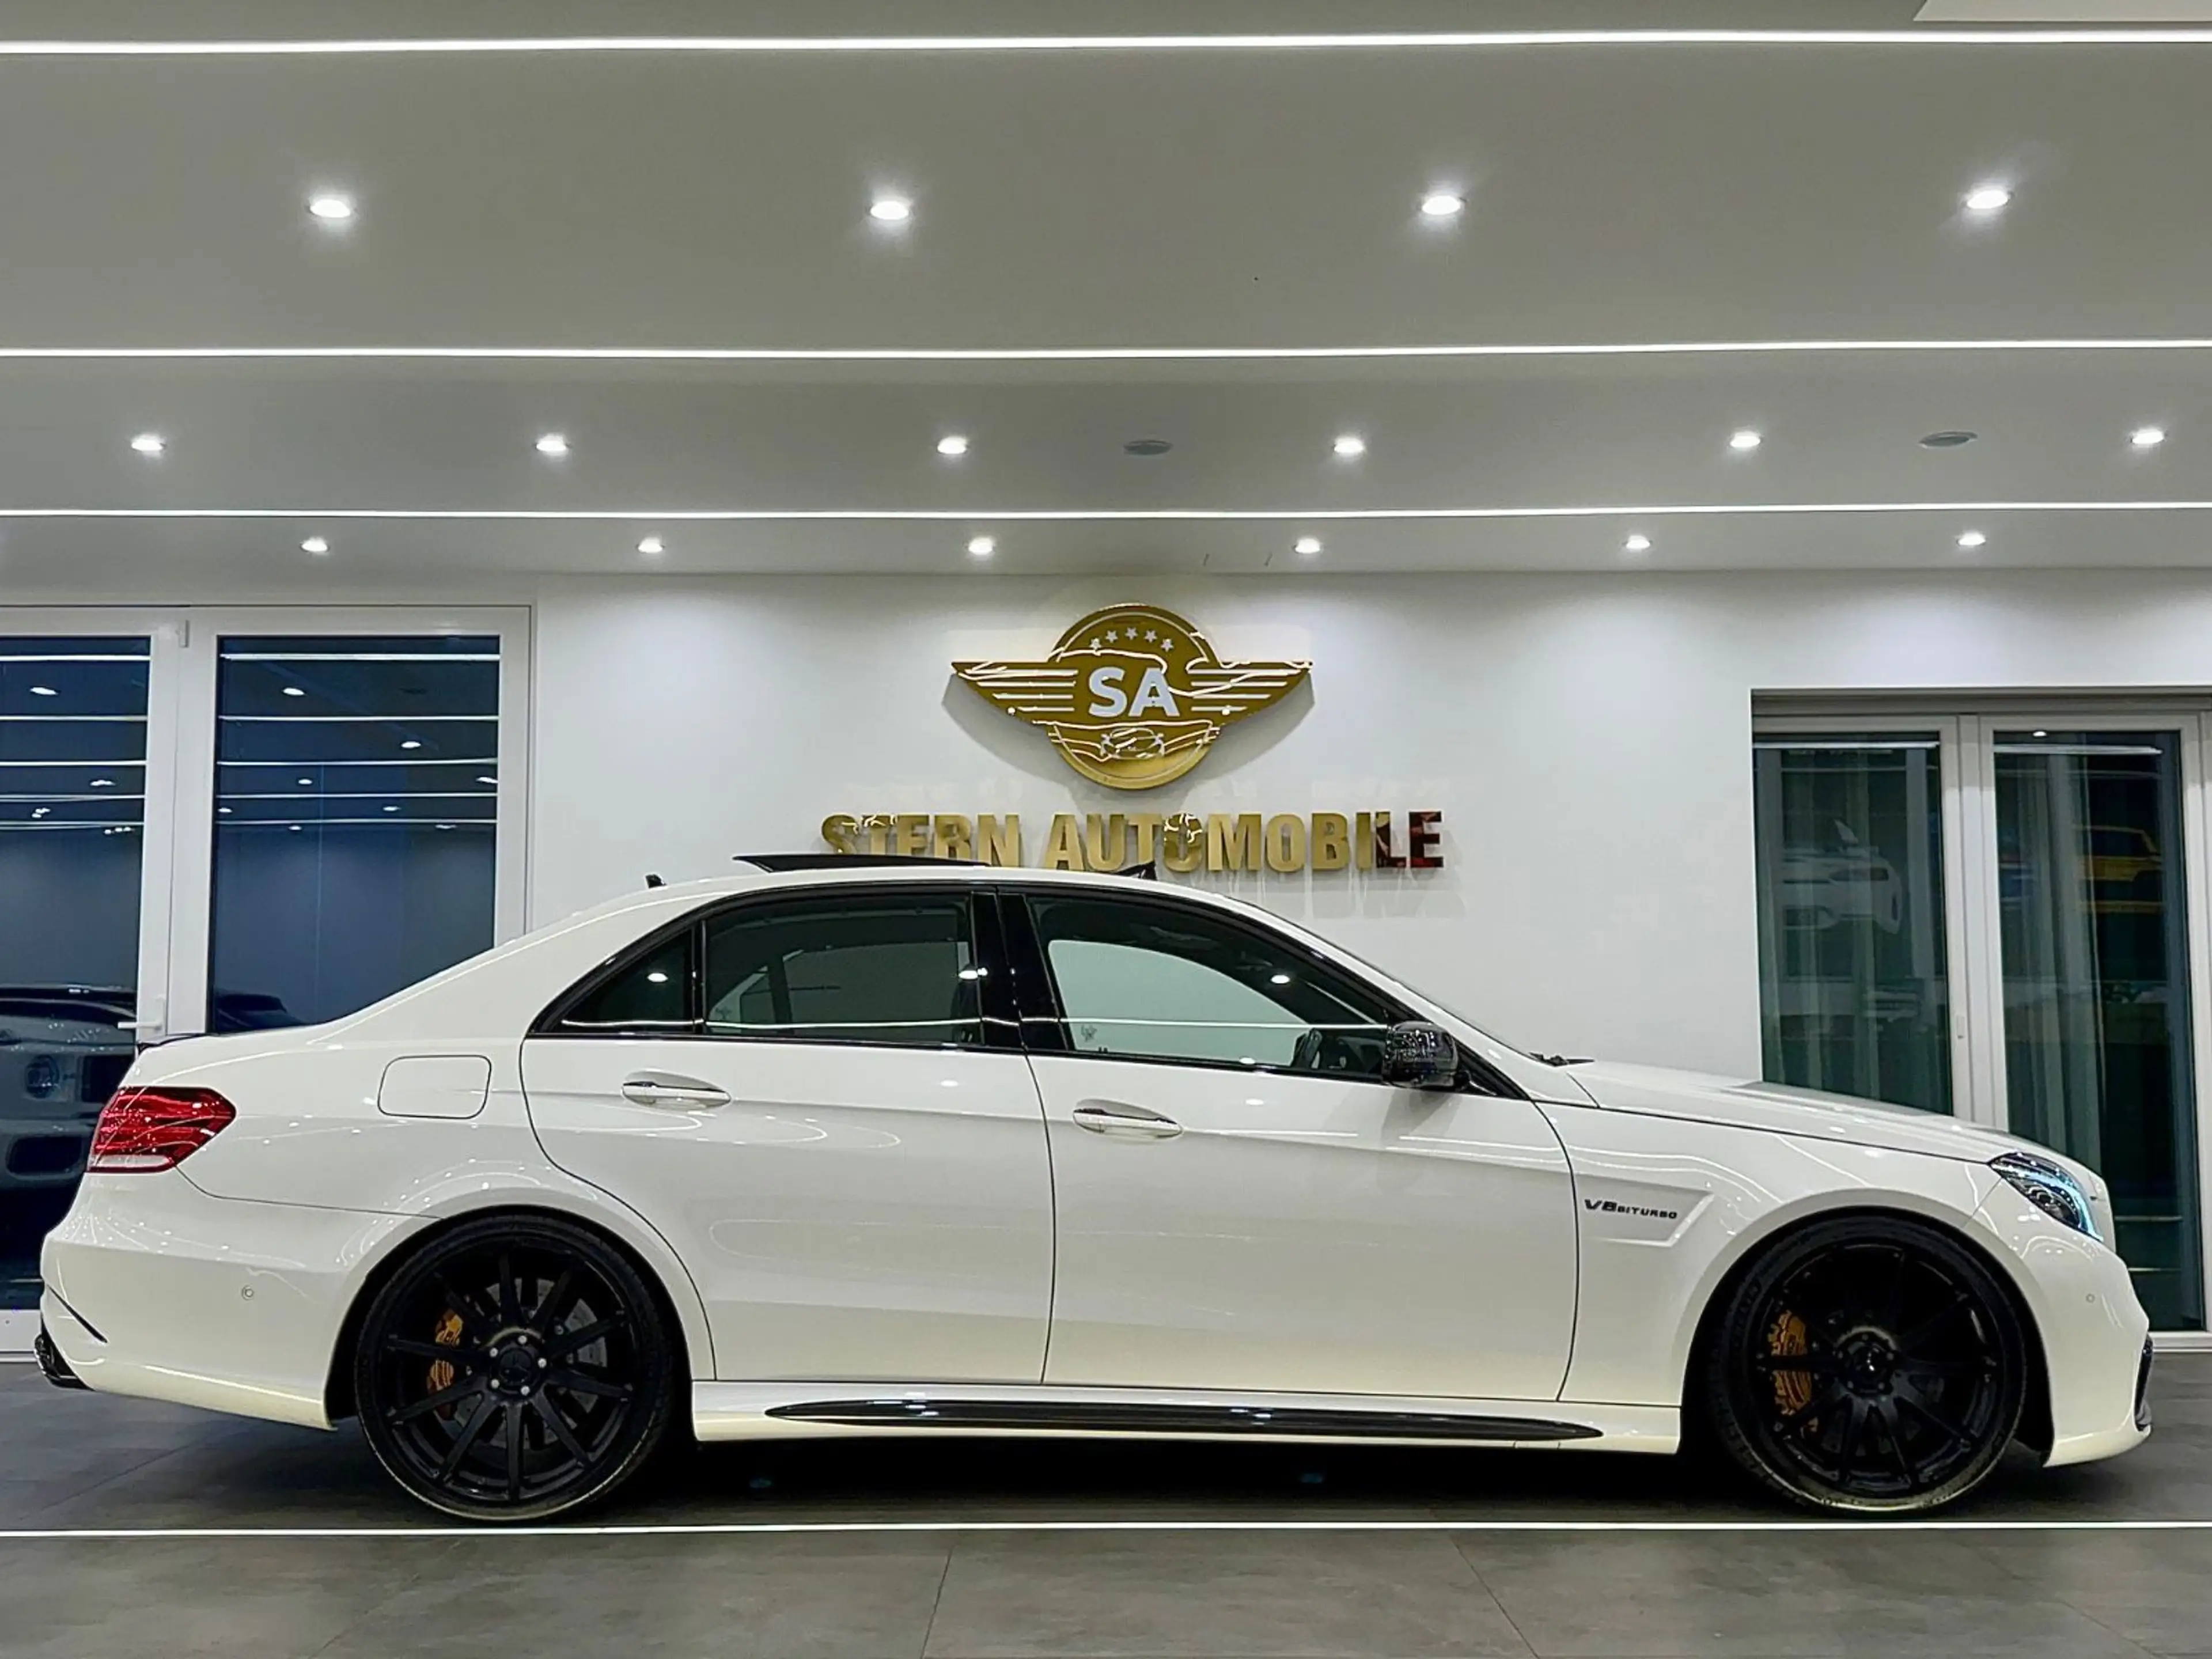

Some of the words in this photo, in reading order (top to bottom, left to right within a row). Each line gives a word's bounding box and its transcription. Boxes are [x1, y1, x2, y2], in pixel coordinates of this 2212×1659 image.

[1088, 666, 1180, 717] SA
[821, 813, 1021, 867] STERN
[1045, 810, 1444, 873] AUTOMOBILE
